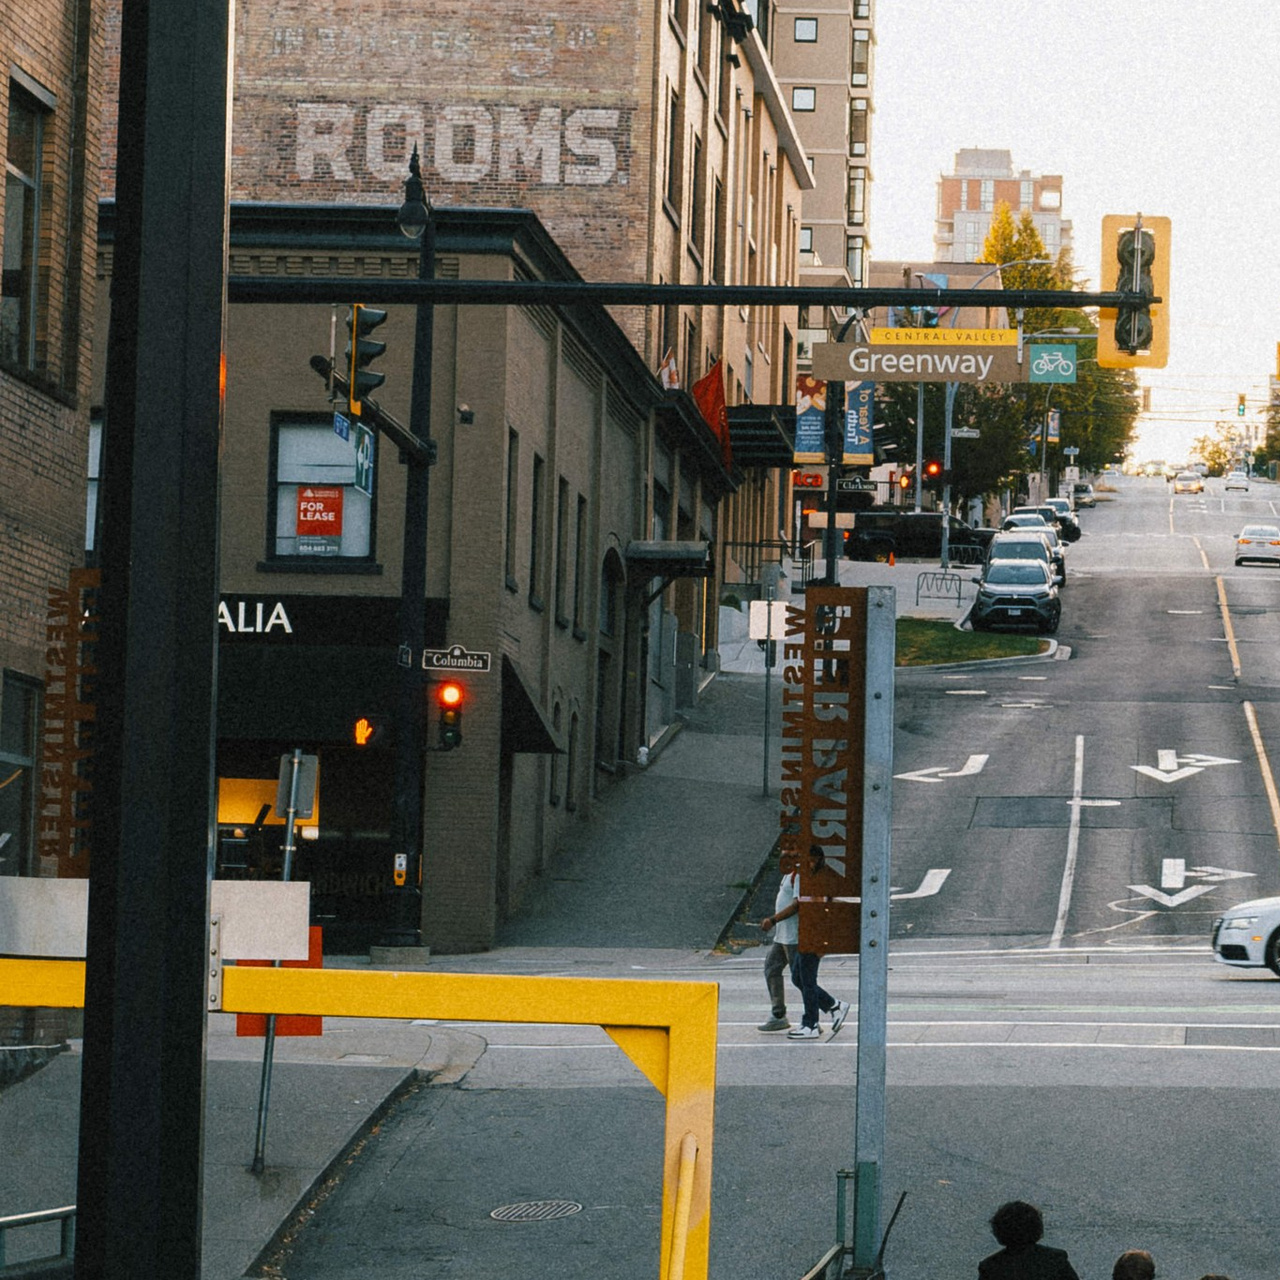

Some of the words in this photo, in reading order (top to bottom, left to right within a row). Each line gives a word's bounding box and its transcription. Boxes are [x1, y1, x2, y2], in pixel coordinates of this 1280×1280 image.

[294, 102, 620, 185] ROOMS
[885, 332, 948, 341] CENTRAL
[957, 332, 1005, 341] VALLEY
[849, 347, 993, 380] Greenway
[300, 501, 324, 511] FOR
[300, 512, 335, 521] LEASE
[432, 653, 483, 668] Columbia
